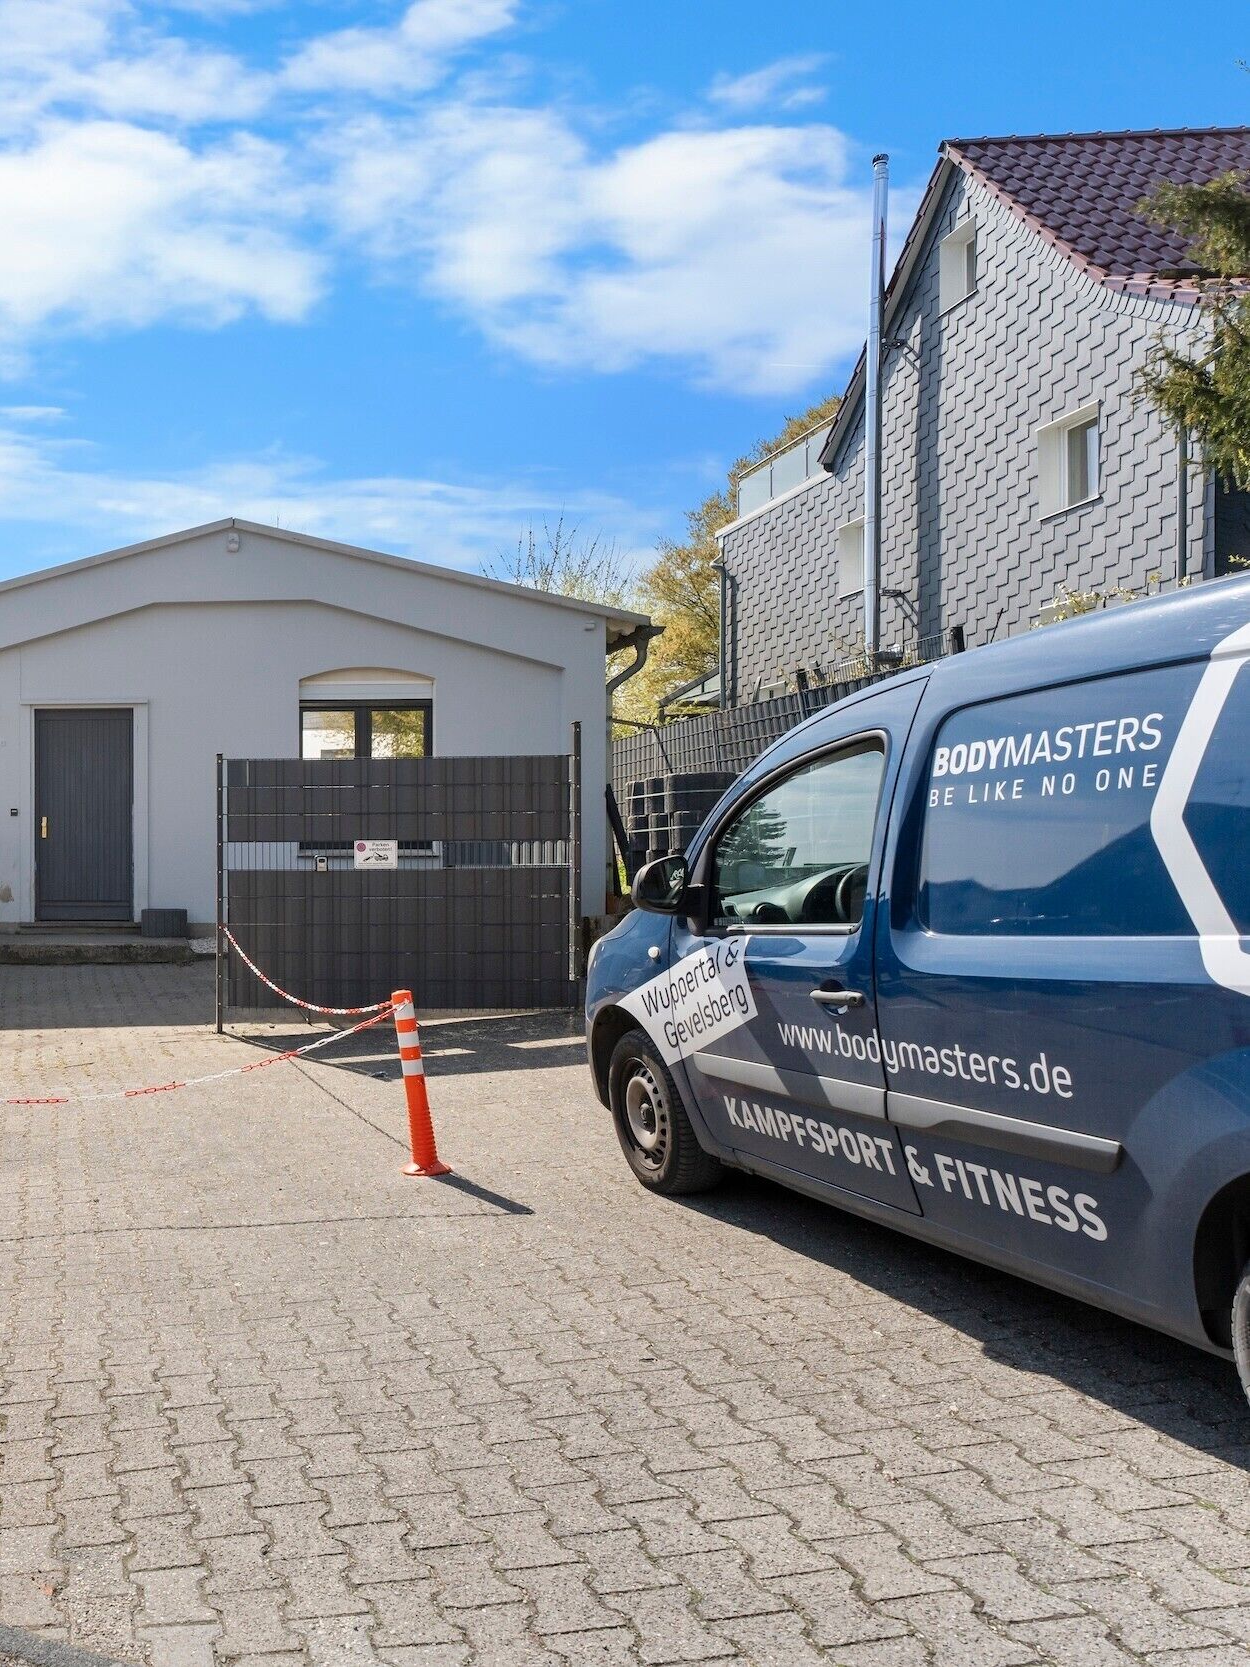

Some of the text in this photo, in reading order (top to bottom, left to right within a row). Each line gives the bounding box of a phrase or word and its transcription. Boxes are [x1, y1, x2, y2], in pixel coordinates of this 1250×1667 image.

[932, 712, 1164, 777] BODYMASTERS
[929, 763, 1158, 807] BE LIKE NO ONE
[640, 939, 739, 1017] Wuppertal &
[663, 984, 749, 1049] Gevelsberg
[777, 1021, 1074, 1099] www.bodymasters.de
[723, 1095, 1108, 1242] KAMPFSPORT & FITNESS
